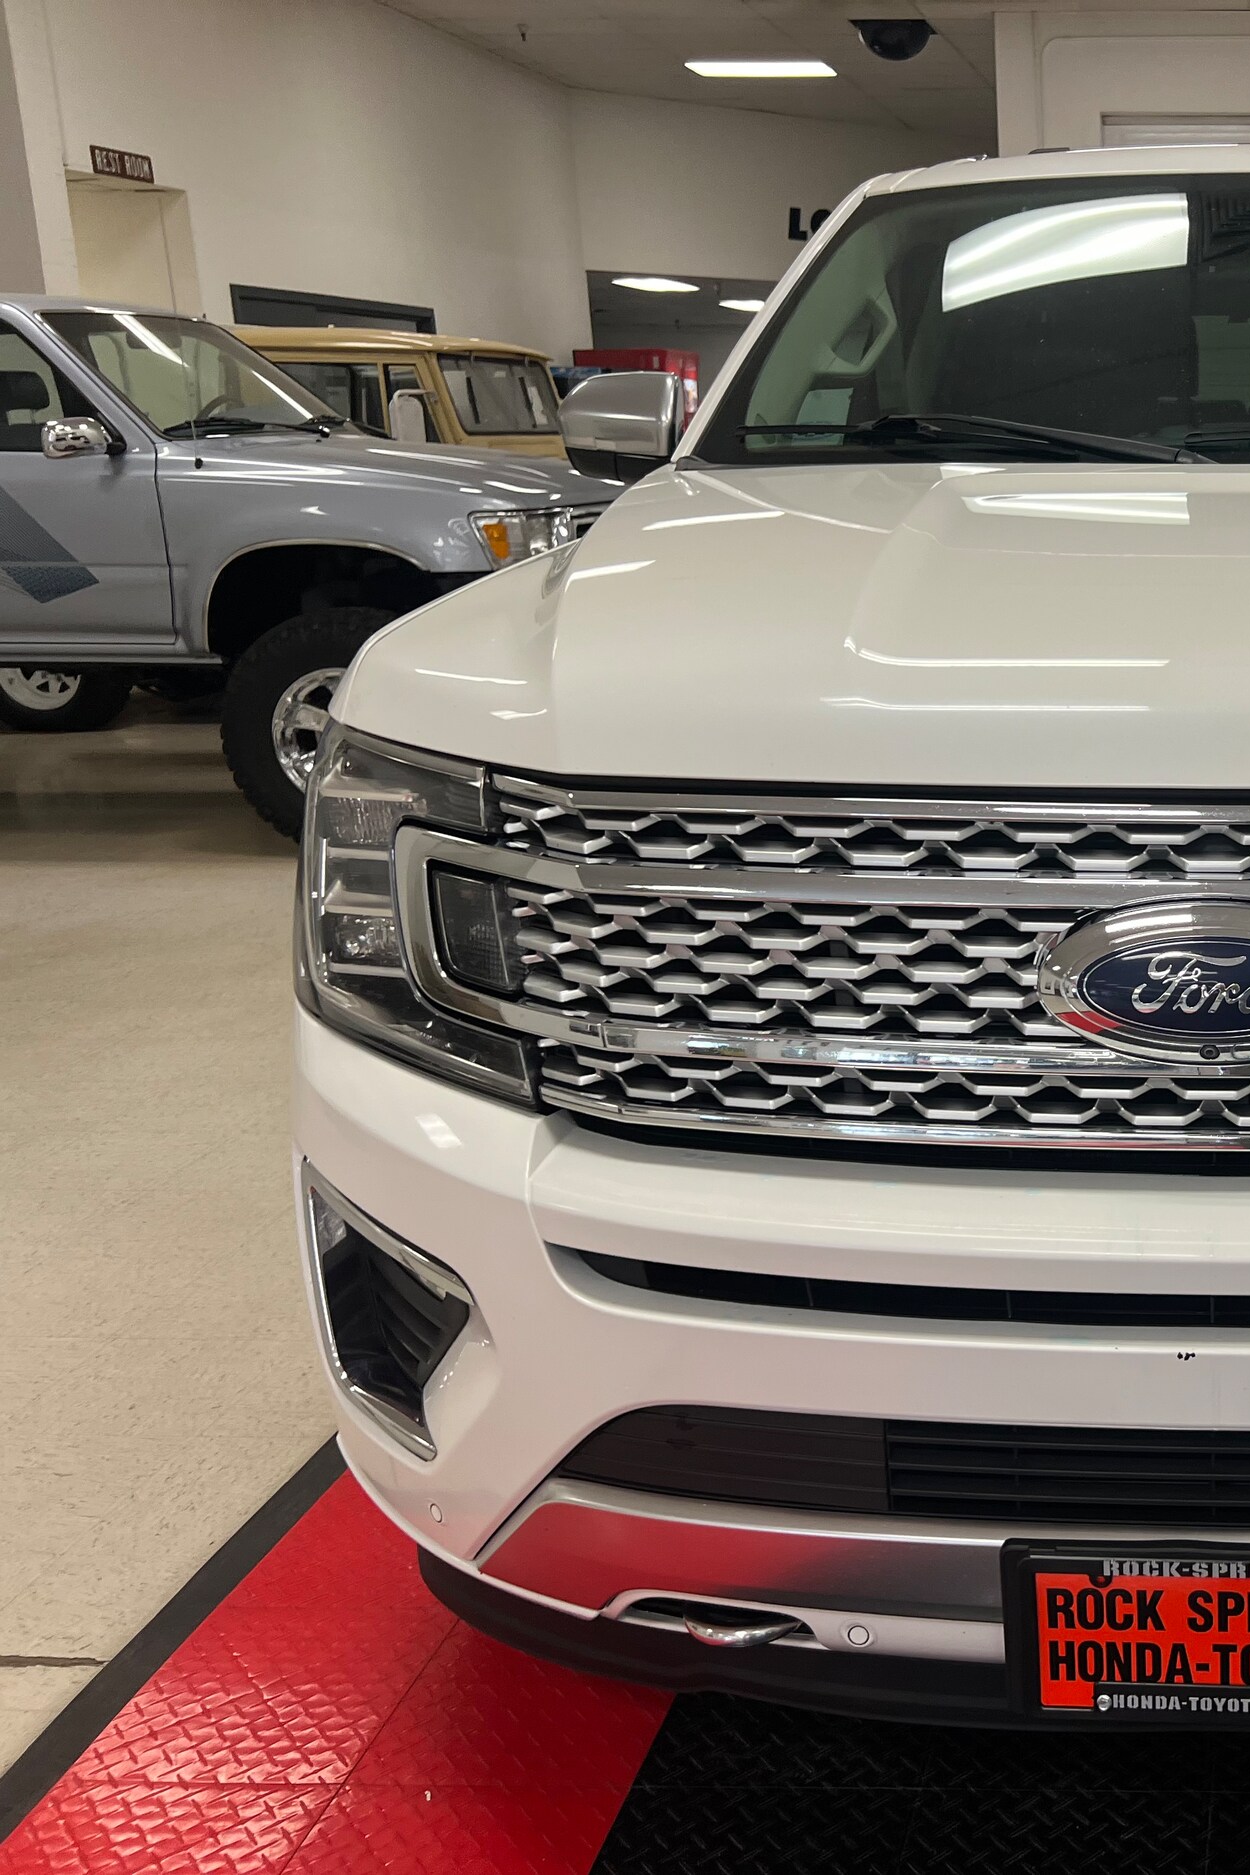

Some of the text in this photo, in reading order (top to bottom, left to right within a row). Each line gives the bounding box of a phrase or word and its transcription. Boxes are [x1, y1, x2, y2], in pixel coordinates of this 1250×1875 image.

[95, 149, 151, 179] REST ROOM
[1046, 1587, 1166, 1632] ROCK
